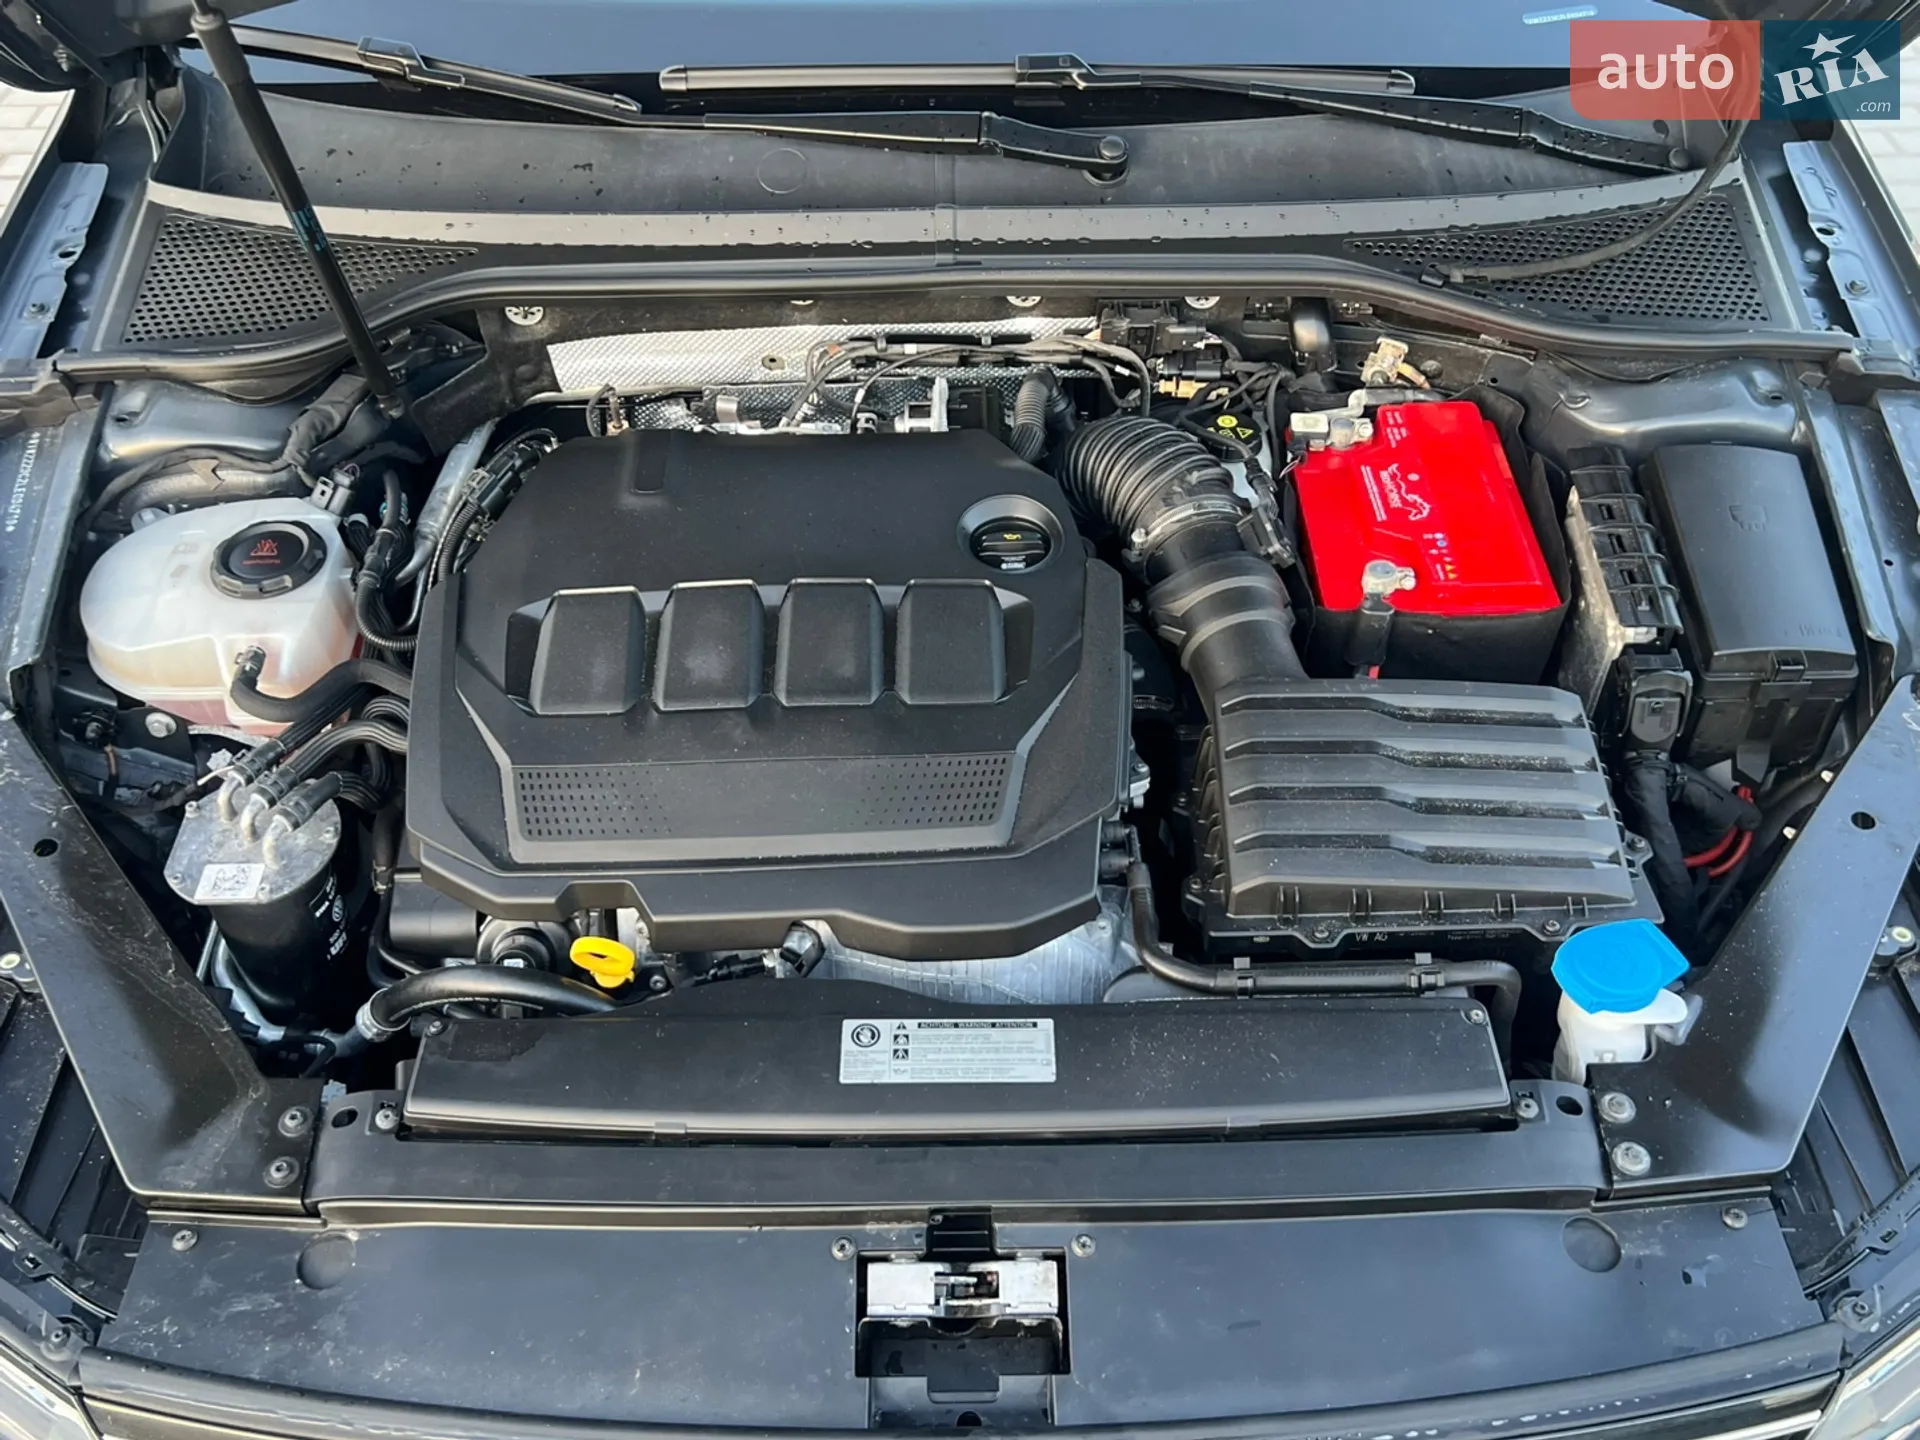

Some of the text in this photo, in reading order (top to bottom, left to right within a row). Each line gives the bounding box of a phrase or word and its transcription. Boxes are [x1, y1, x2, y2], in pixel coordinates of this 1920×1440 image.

[1354, 931, 1369, 942] VW
[1373, 931, 1389, 942] AG
[958, 1021, 992, 1029] WARNING
